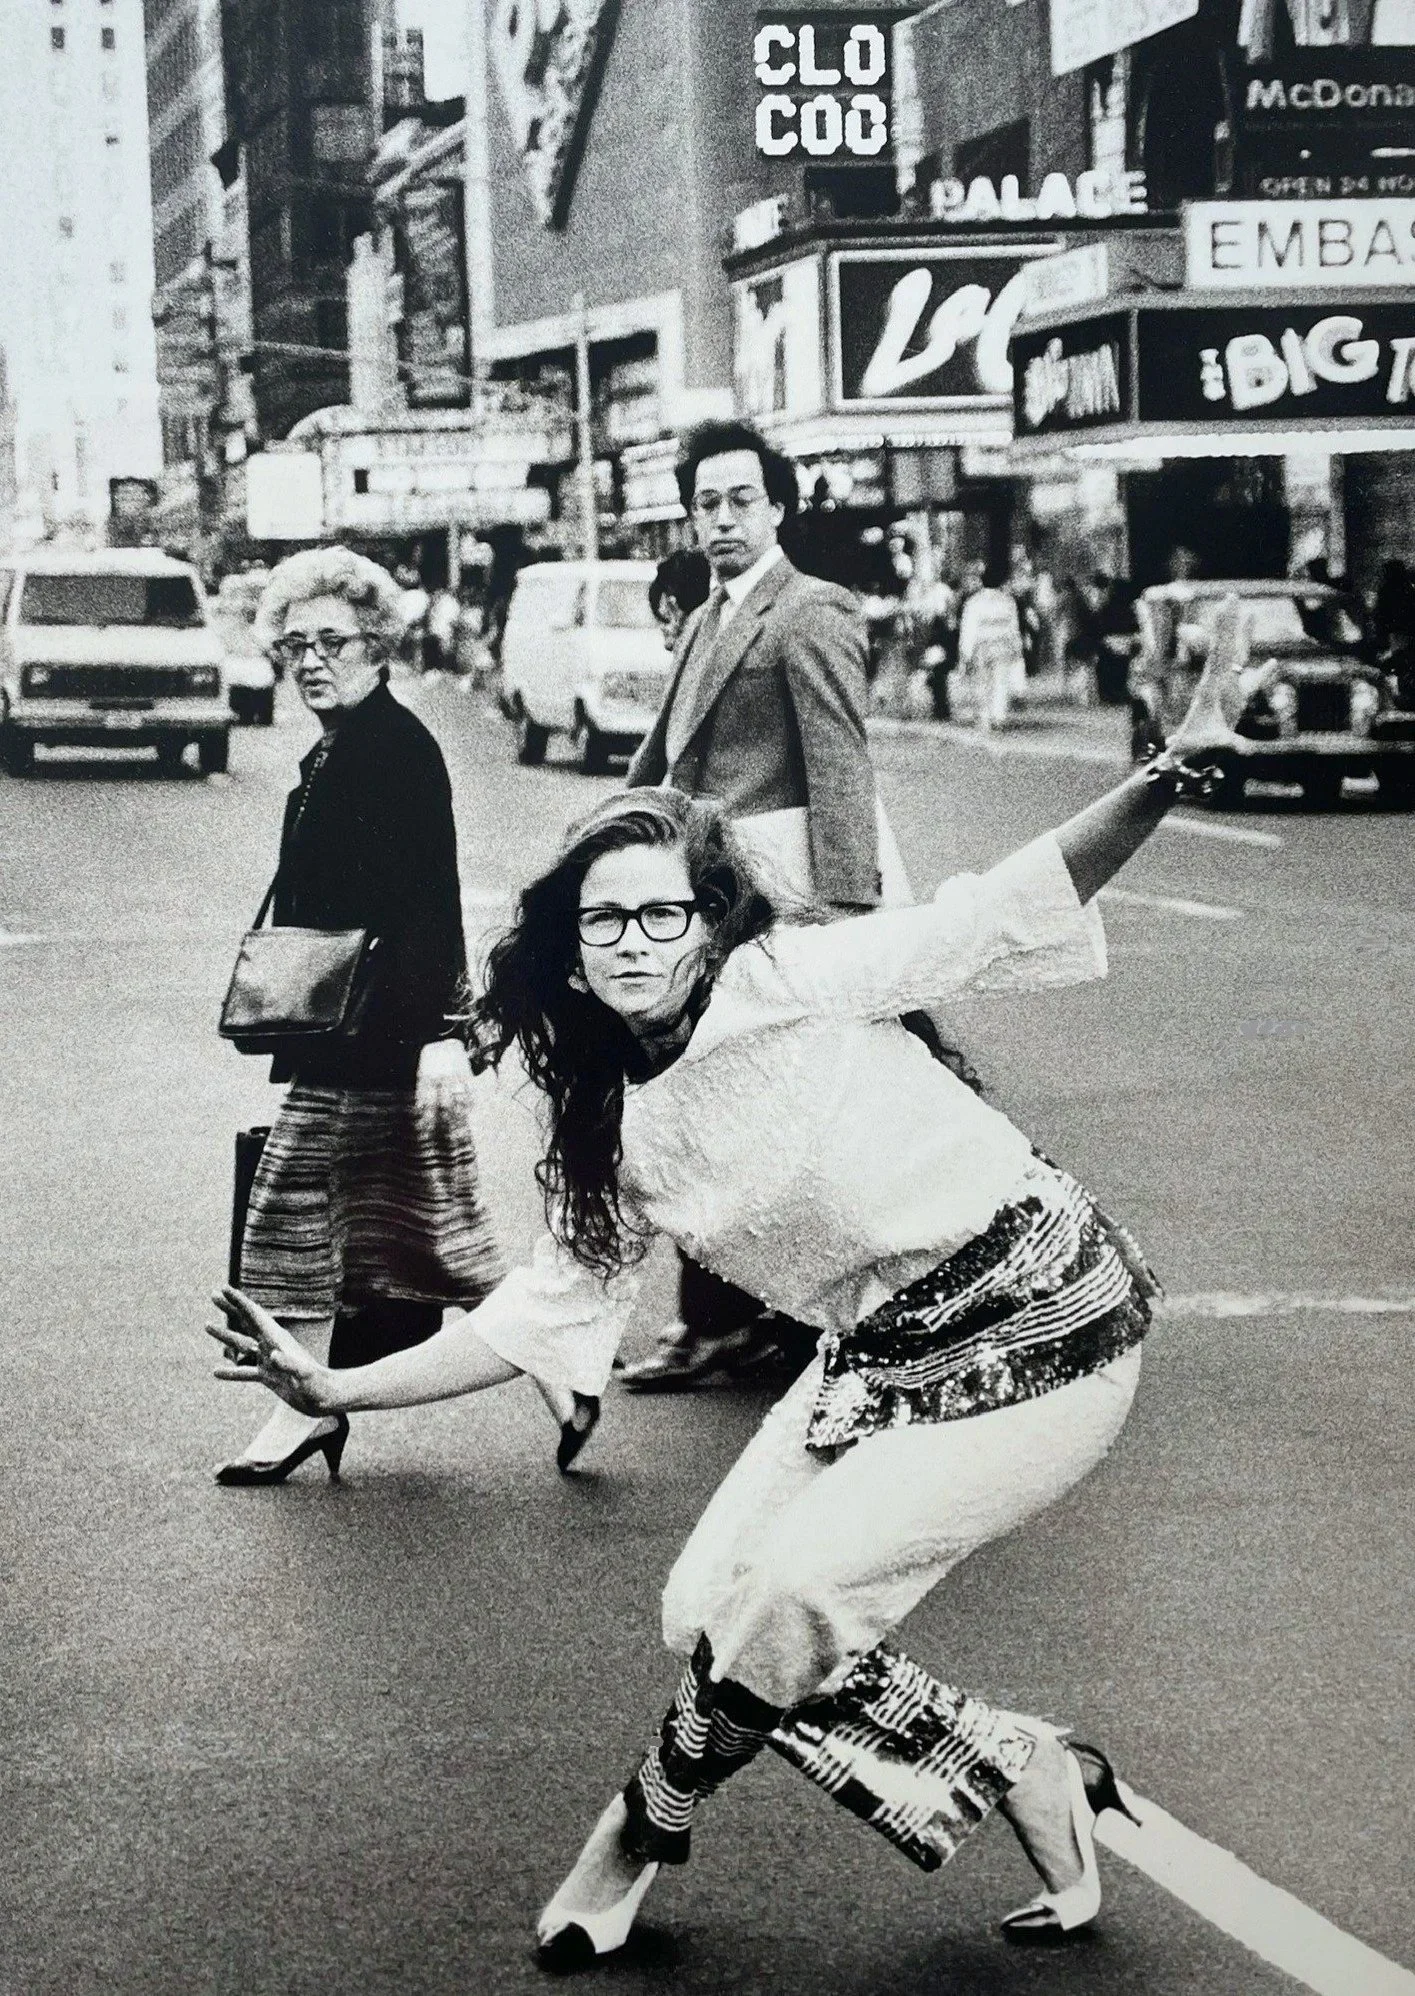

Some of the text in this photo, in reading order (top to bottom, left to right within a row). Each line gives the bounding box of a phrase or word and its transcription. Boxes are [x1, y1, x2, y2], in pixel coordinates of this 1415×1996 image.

[754, 24, 885, 86] CLO
[929, 170, 1149, 222] PALACE
[1211, 219, 1415, 269] EMBA
[1225, 315, 1380, 411] BIG
